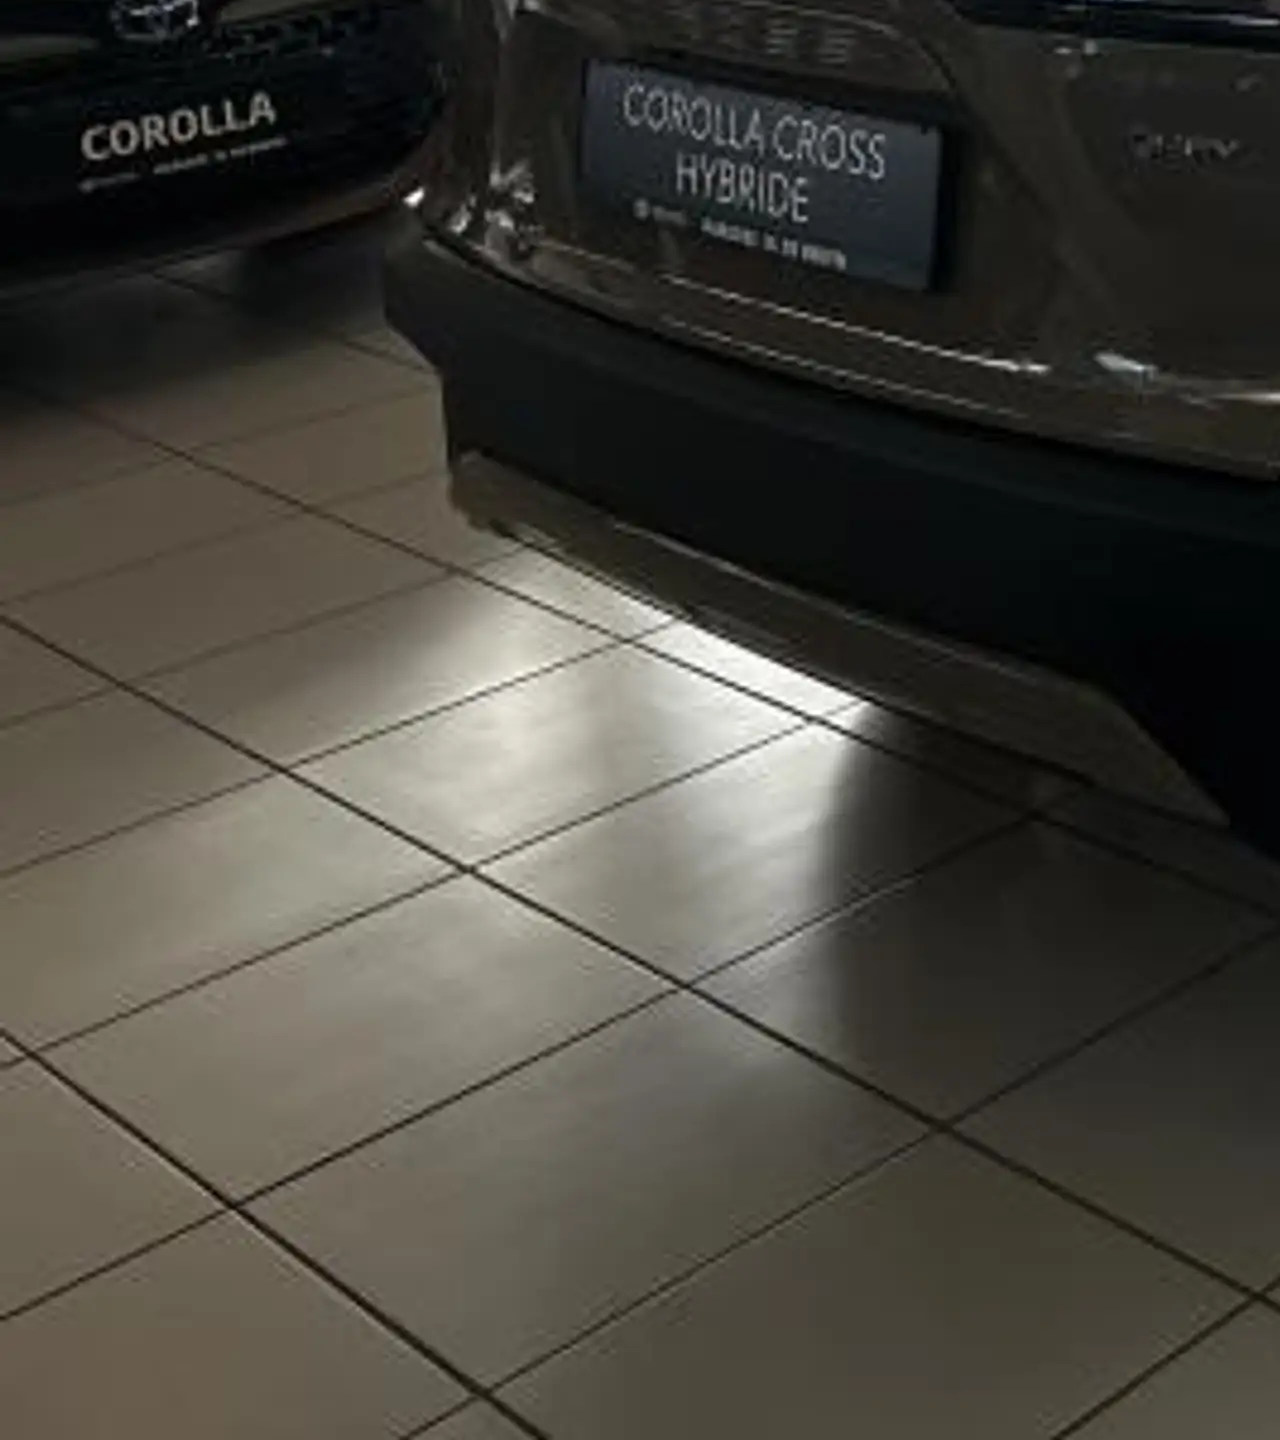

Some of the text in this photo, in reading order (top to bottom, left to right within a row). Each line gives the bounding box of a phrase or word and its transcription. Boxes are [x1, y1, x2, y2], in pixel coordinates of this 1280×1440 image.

[80, 90, 277, 161] COROLLA
[622, 82, 887, 181] COROLLA CROSS
[675, 153, 809, 223] HYBRIDE
